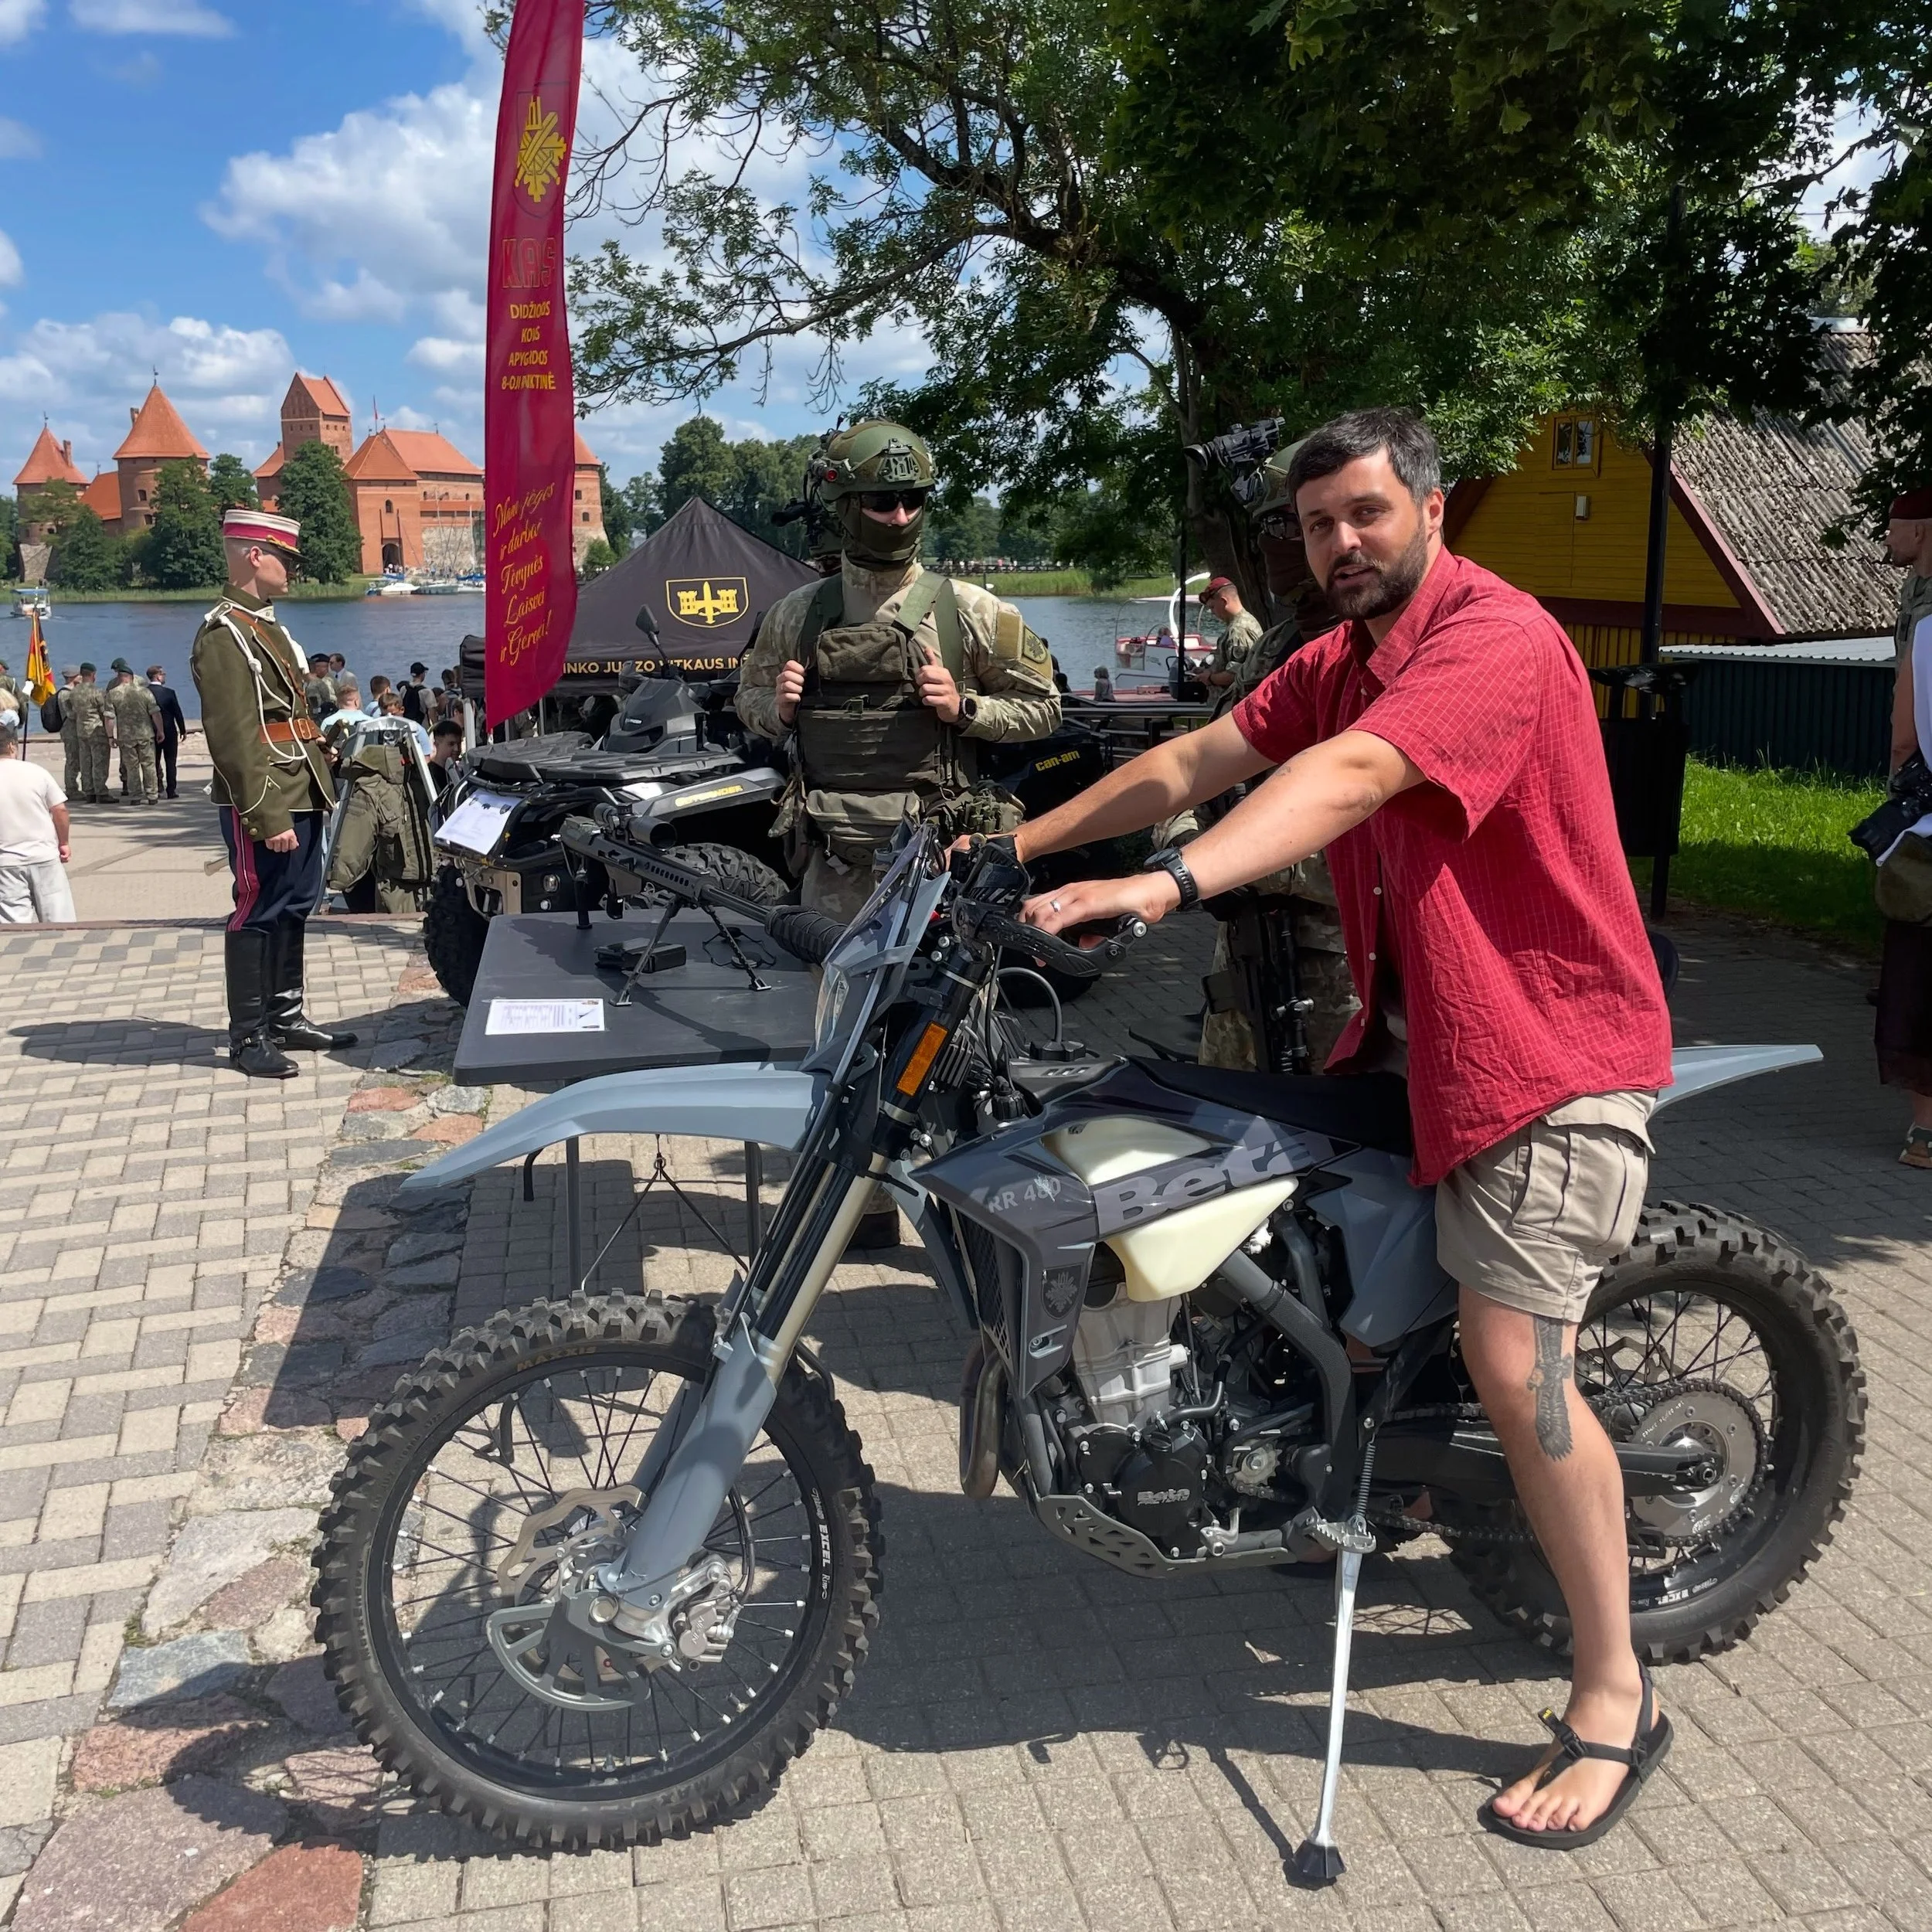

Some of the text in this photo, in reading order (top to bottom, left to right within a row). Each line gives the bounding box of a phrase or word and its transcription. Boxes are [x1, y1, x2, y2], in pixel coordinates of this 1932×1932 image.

[604, 657, 656, 673] JUZO
[1036, 750, 1080, 771] can-am
[1093, 1131, 1327, 1236] Beta
[988, 1191, 1019, 1213] RR
[818, 1524, 831, 1567] EXCEL
[692, 1615, 704, 1645] NIIN
